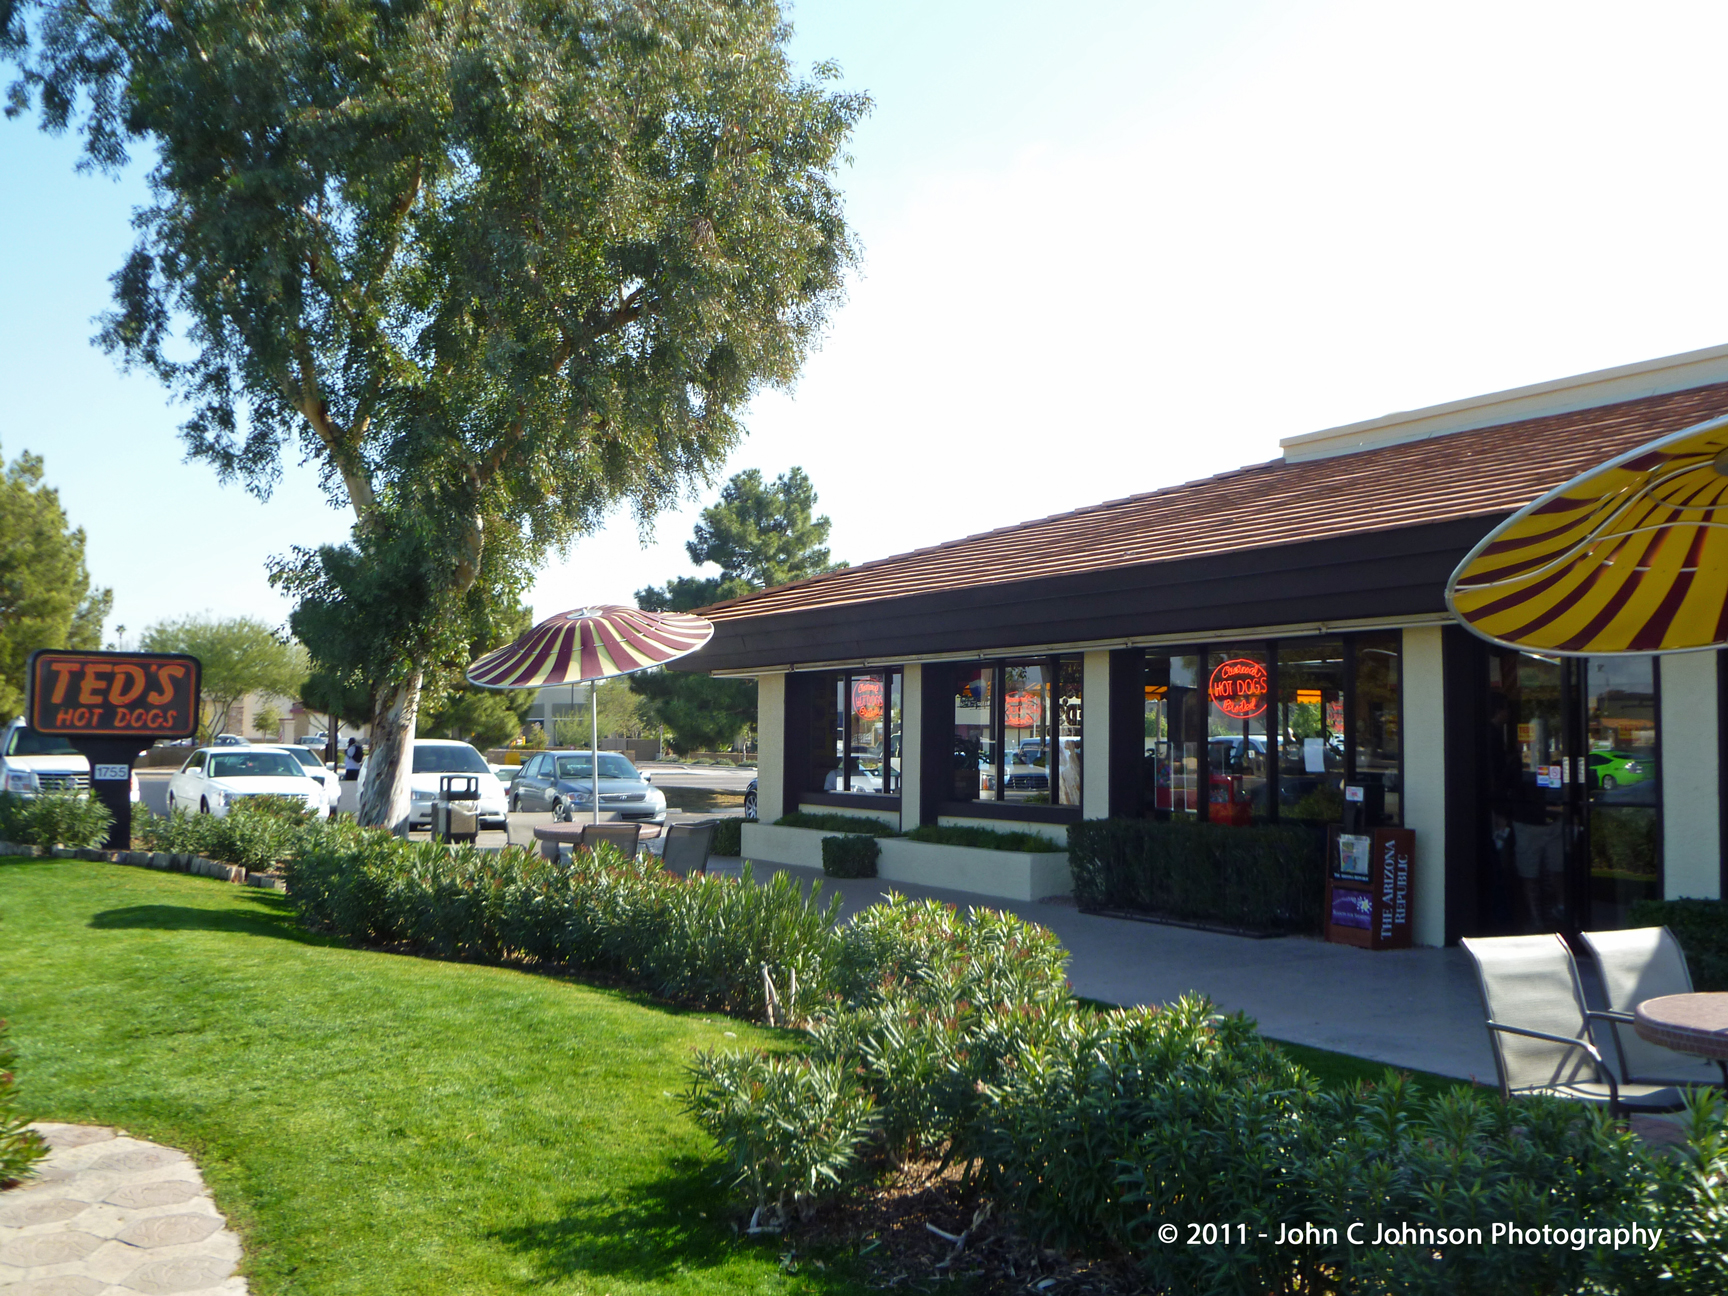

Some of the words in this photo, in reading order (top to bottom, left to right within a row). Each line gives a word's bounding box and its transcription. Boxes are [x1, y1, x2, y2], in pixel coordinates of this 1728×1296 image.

[51, 662, 186, 706] TED'S
[1214, 680, 1233, 697] HOT
[1236, 677, 1268, 696] DOGS
[55, 707, 104, 728] HOT
[114, 707, 178, 729] DOGS
[97, 766, 128, 778] 1755
[1382, 839, 1396, 906] ARIZONA
[1395, 854, 1409, 924] REPUBLIC
[1380, 908, 1393, 941] THE
